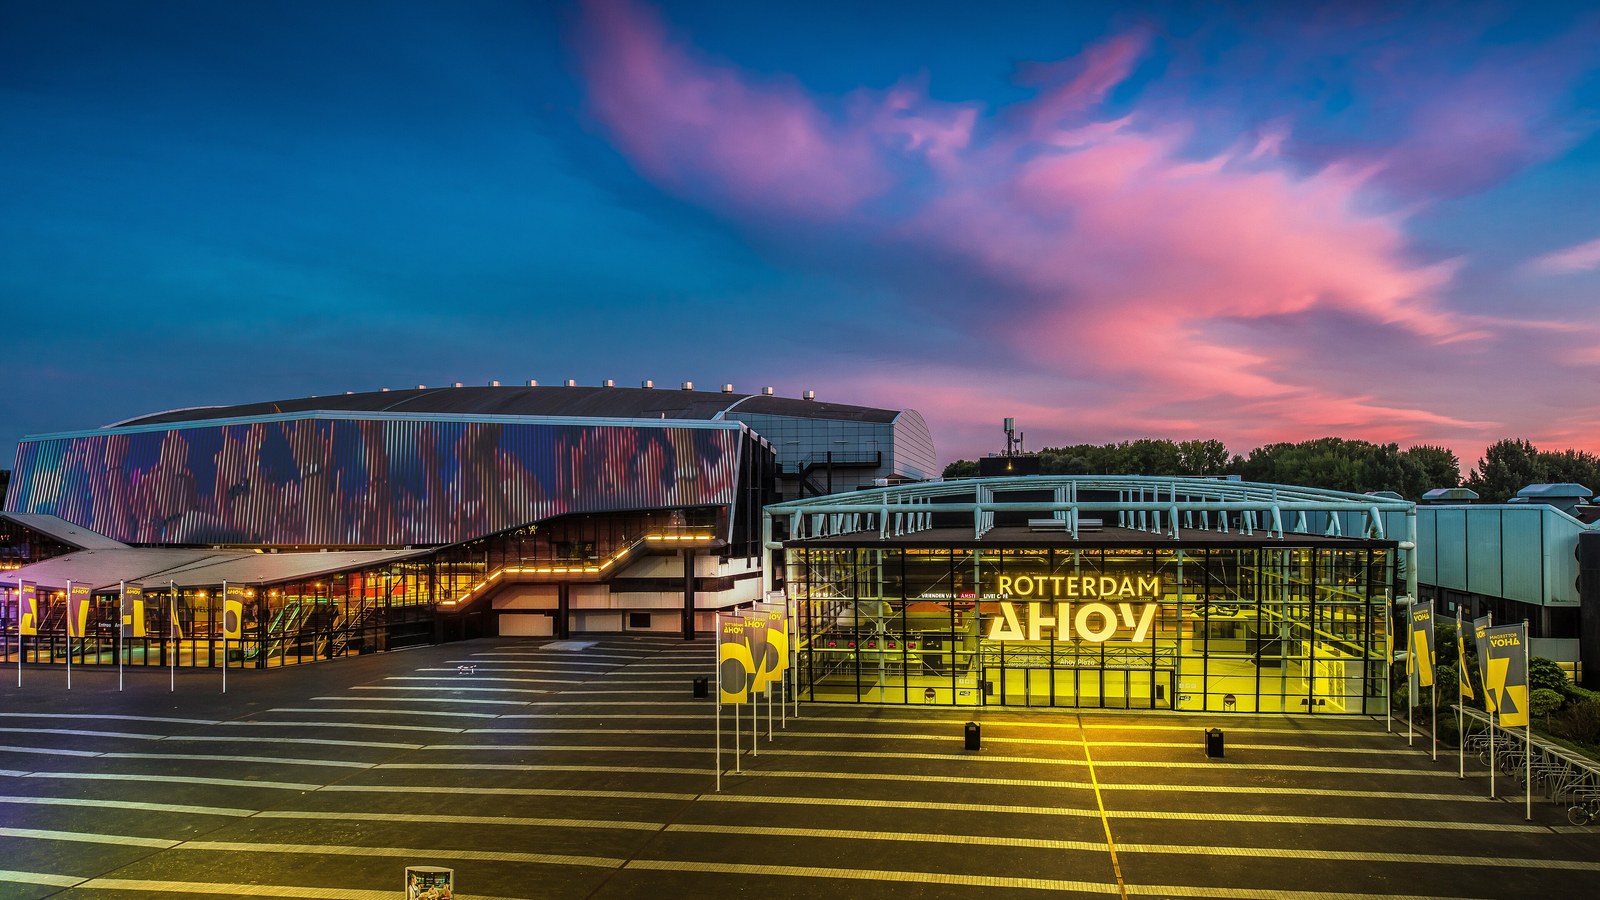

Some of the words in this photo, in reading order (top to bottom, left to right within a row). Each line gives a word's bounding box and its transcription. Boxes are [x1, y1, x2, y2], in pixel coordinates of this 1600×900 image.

[999, 576, 1159, 597] ROTTERDAM
[988, 602, 1158, 642] AHOY
[1060, 658, 1076, 667] Ahoy
